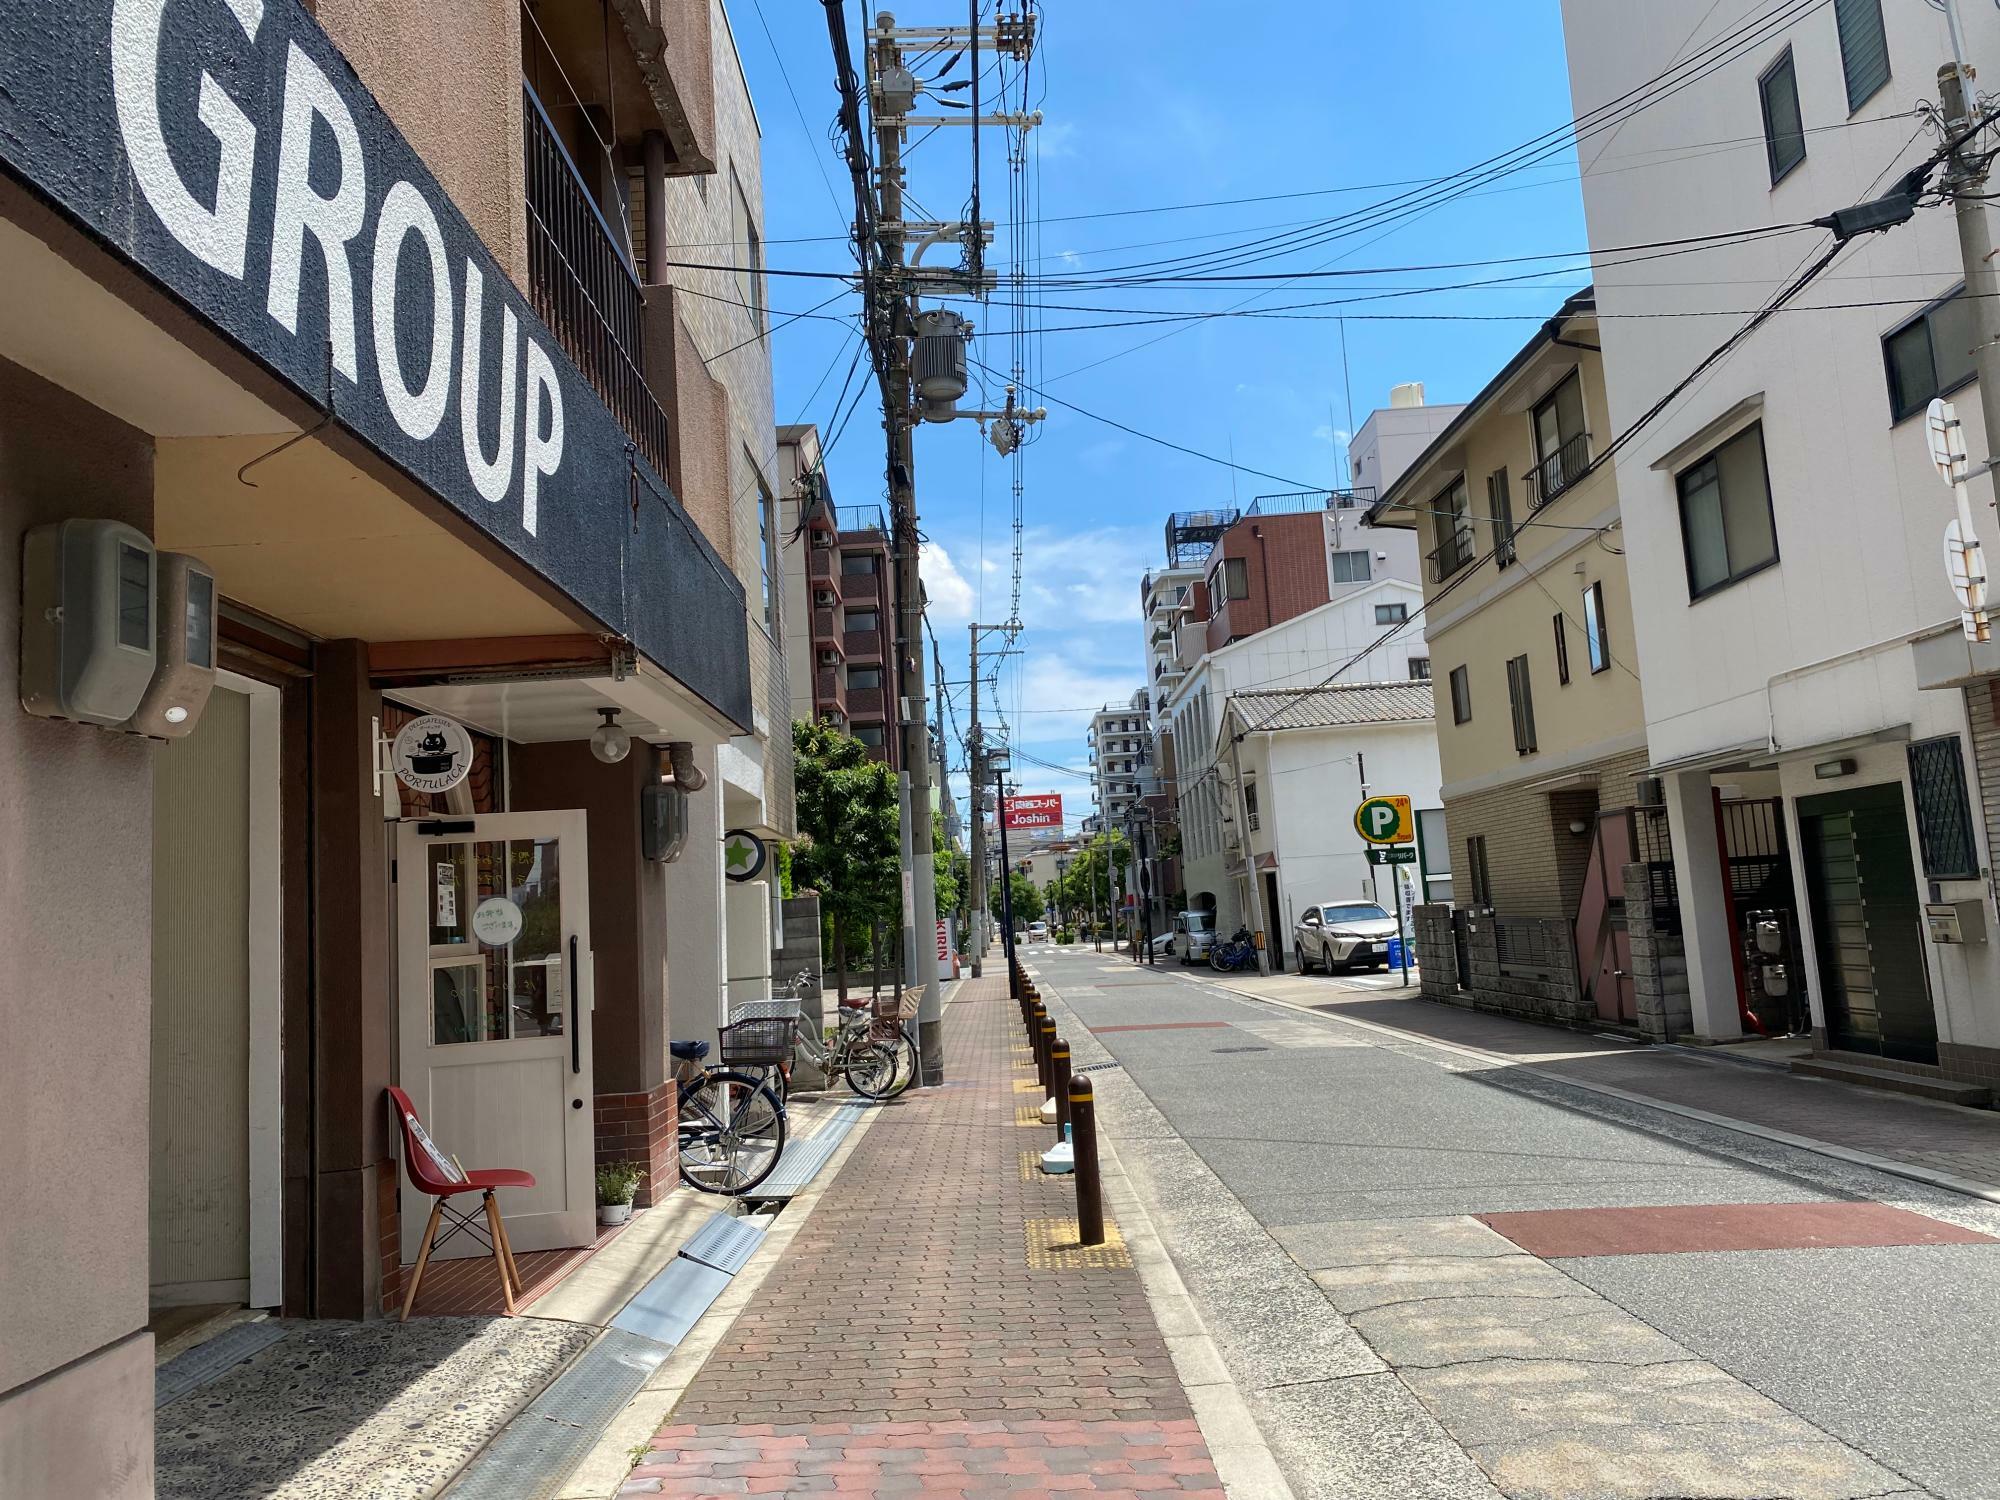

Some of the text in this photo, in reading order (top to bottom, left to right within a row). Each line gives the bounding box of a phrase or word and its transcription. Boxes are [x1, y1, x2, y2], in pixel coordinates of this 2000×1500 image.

[110, 0, 565, 538] GROUP
[398, 763, 465, 789] PORTULACA
[1011, 813, 1050, 825] Joshin
[1371, 806, 1394, 836] P
[935, 918, 948, 961] KIRIN
